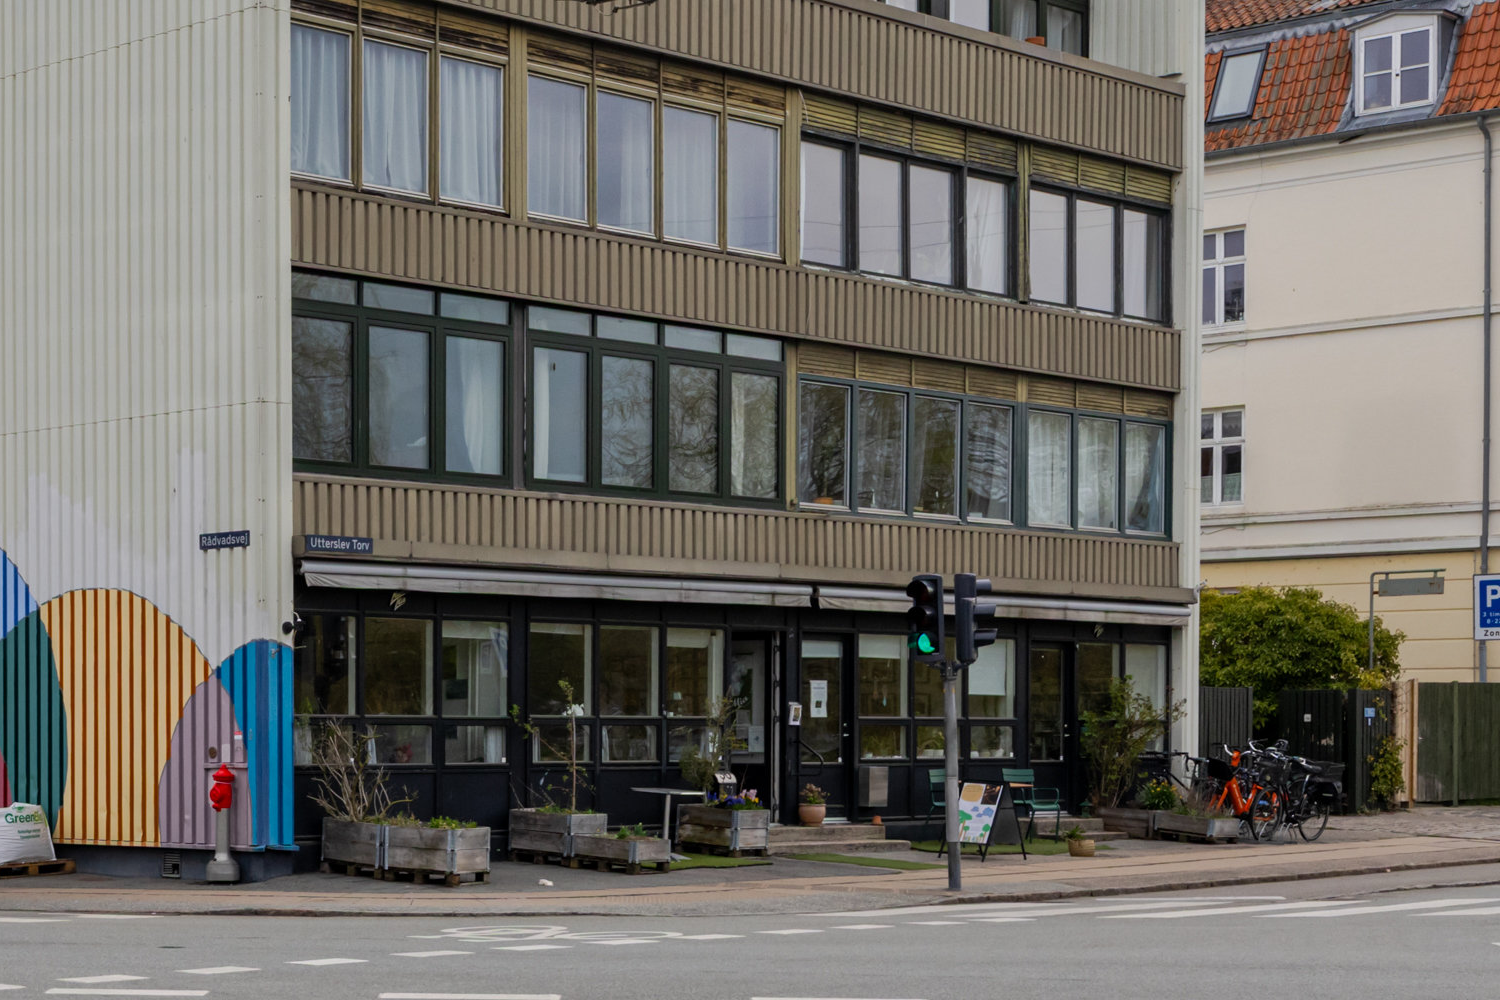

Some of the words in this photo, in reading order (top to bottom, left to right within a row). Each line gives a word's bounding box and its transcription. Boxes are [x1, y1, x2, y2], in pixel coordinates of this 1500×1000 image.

[201, 533, 248, 547] Rådvadsvej
[310, 537, 350, 550] Utterslev
[352, 539, 370, 550] Torv
[1486, 585, 1500, 608] P
